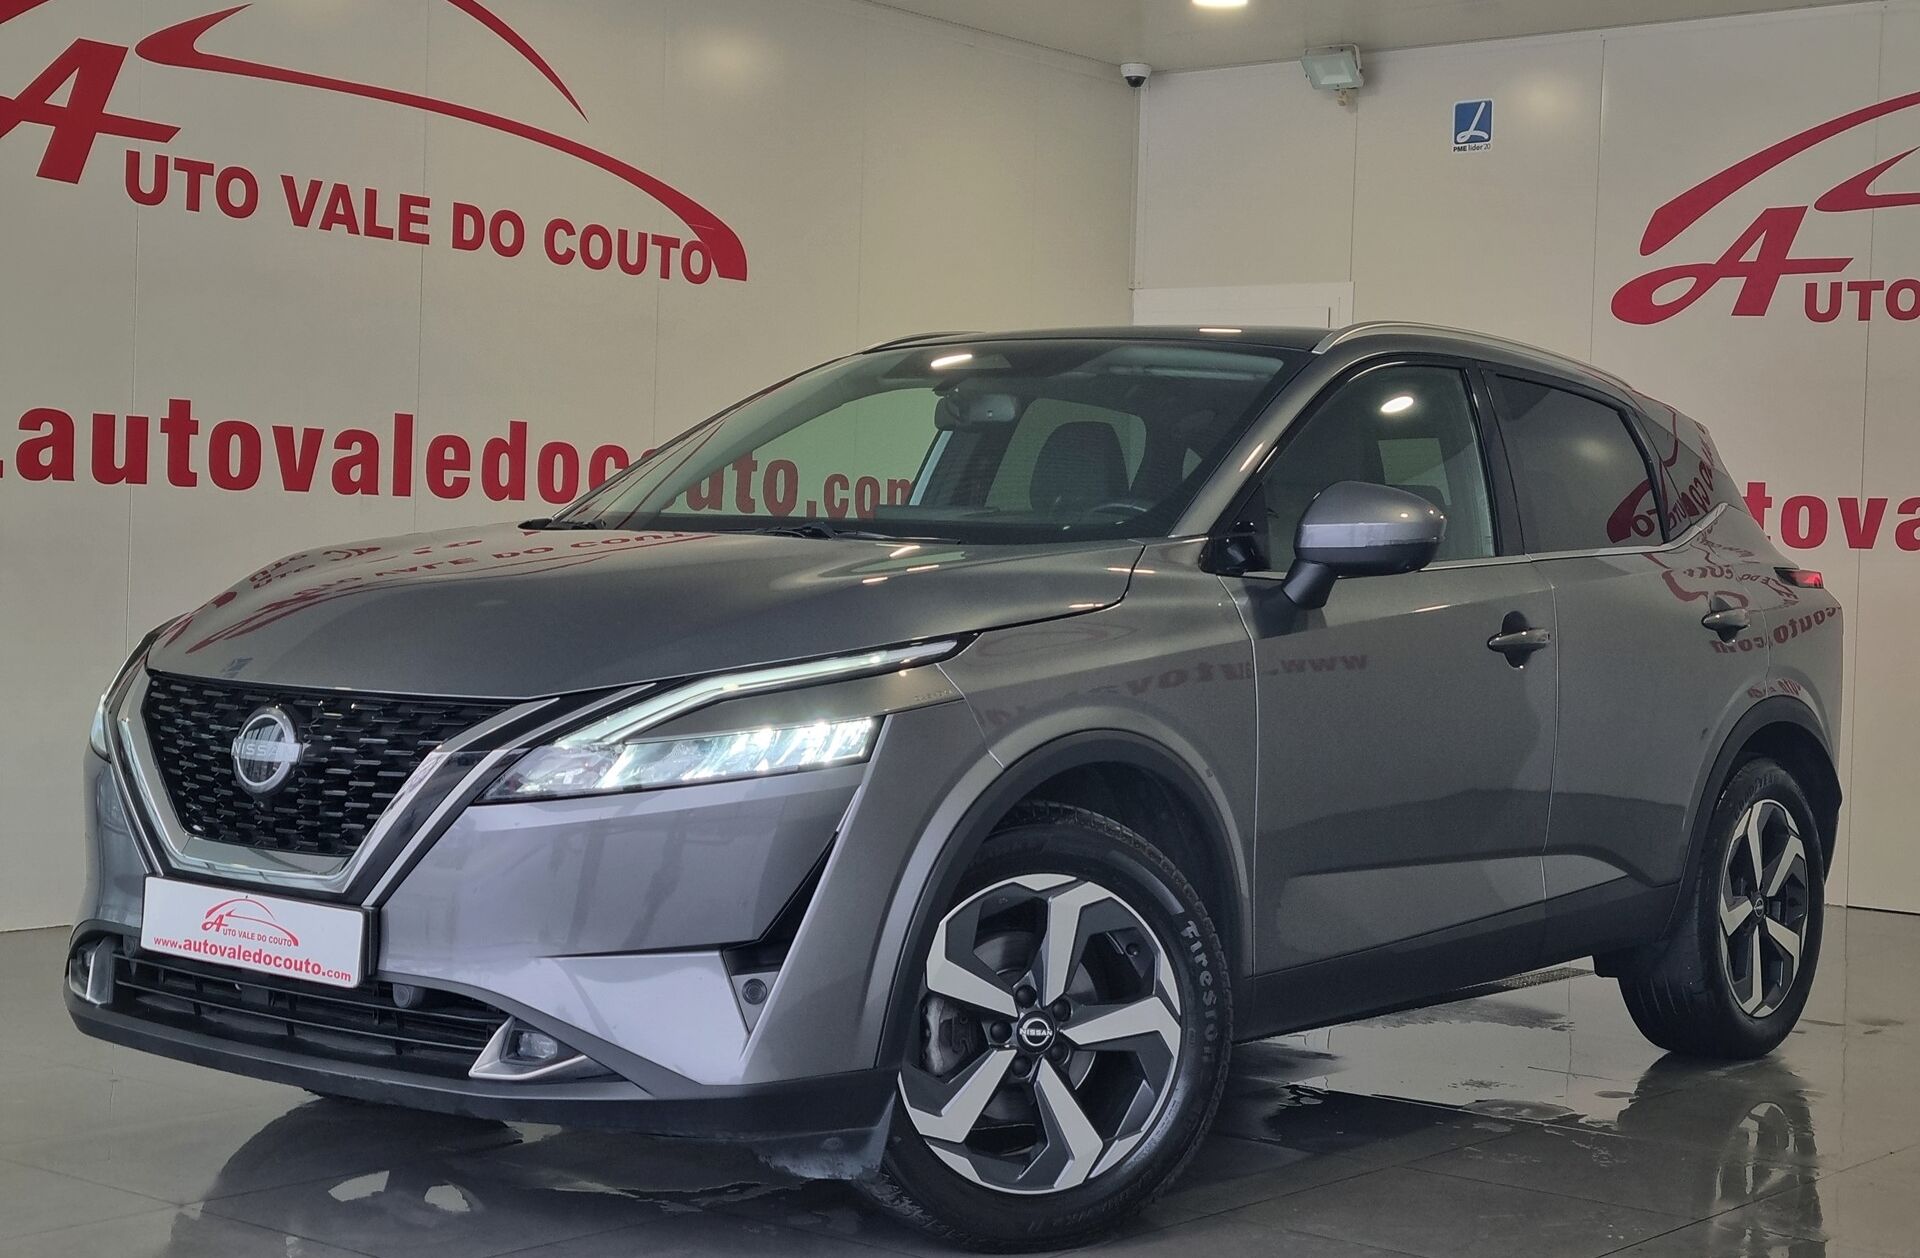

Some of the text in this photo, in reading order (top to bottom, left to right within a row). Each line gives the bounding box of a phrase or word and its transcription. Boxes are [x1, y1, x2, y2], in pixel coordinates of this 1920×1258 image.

[0, 38, 713, 285] AUTO VALE DO COUTO
[1610, 205, 1920, 325] AUTO
[231, 741, 298, 763] NISSA
[201, 914, 292, 947] AUTO VALE DO COUTO
[153, 936, 351, 982] www.autovaledocouto.com
[1020, 1028, 1053, 1037] NISSAN
